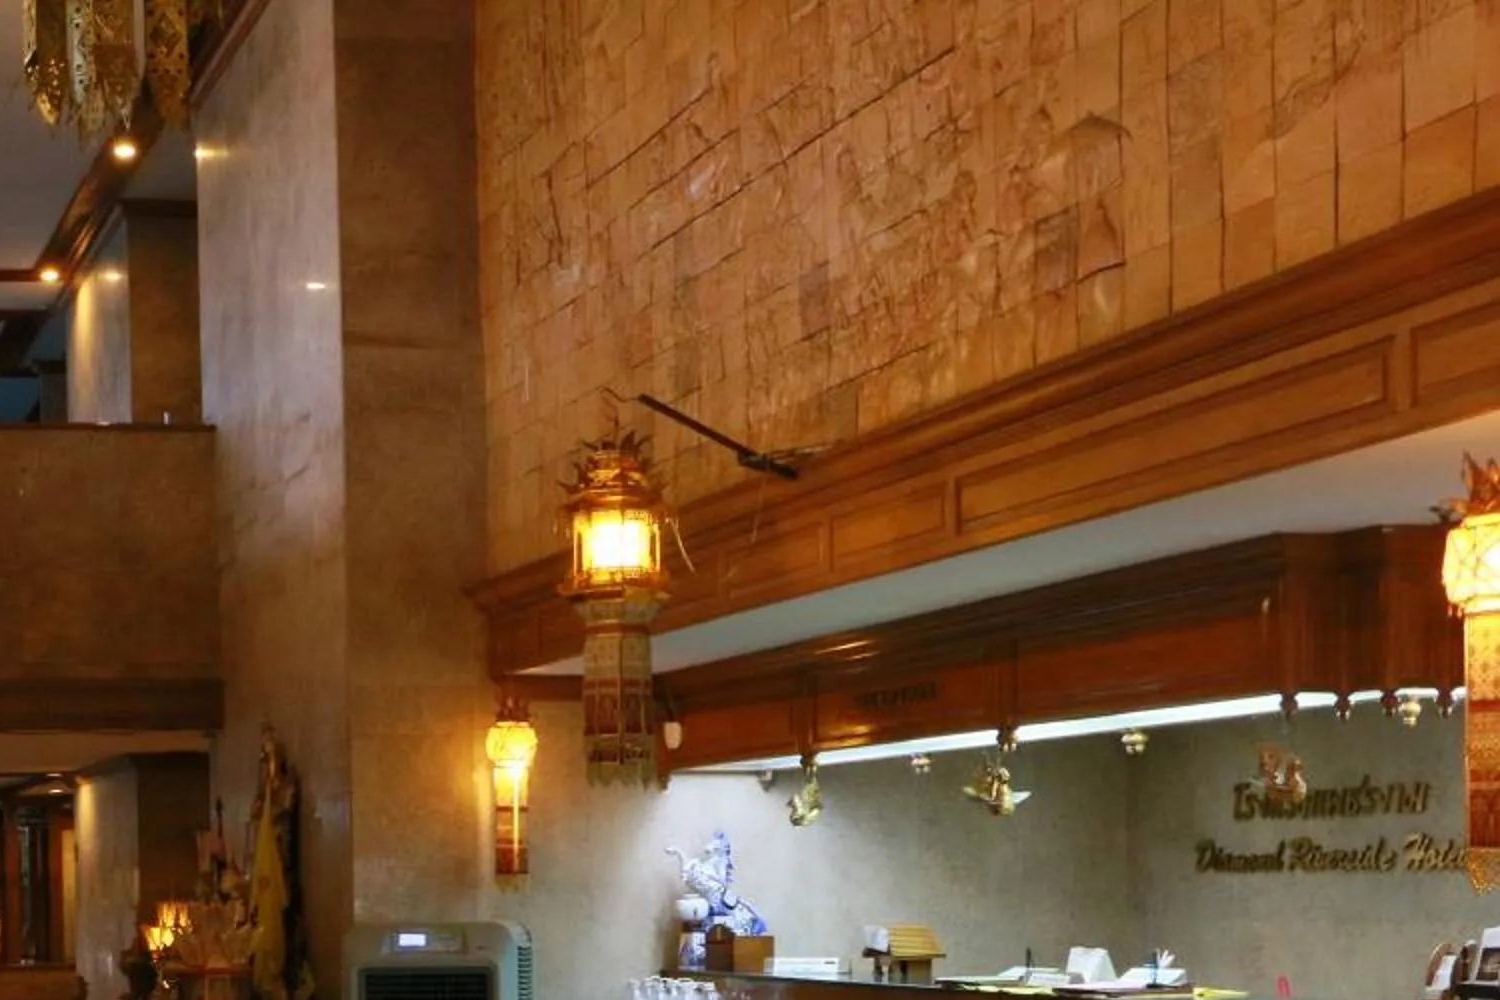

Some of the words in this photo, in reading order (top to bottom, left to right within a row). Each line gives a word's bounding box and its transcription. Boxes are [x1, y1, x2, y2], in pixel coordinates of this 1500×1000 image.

[1195, 838, 1285, 873] Diamond
[1291, 836, 1398, 872] Riverside
[1403, 832, 1470, 871] Hote
